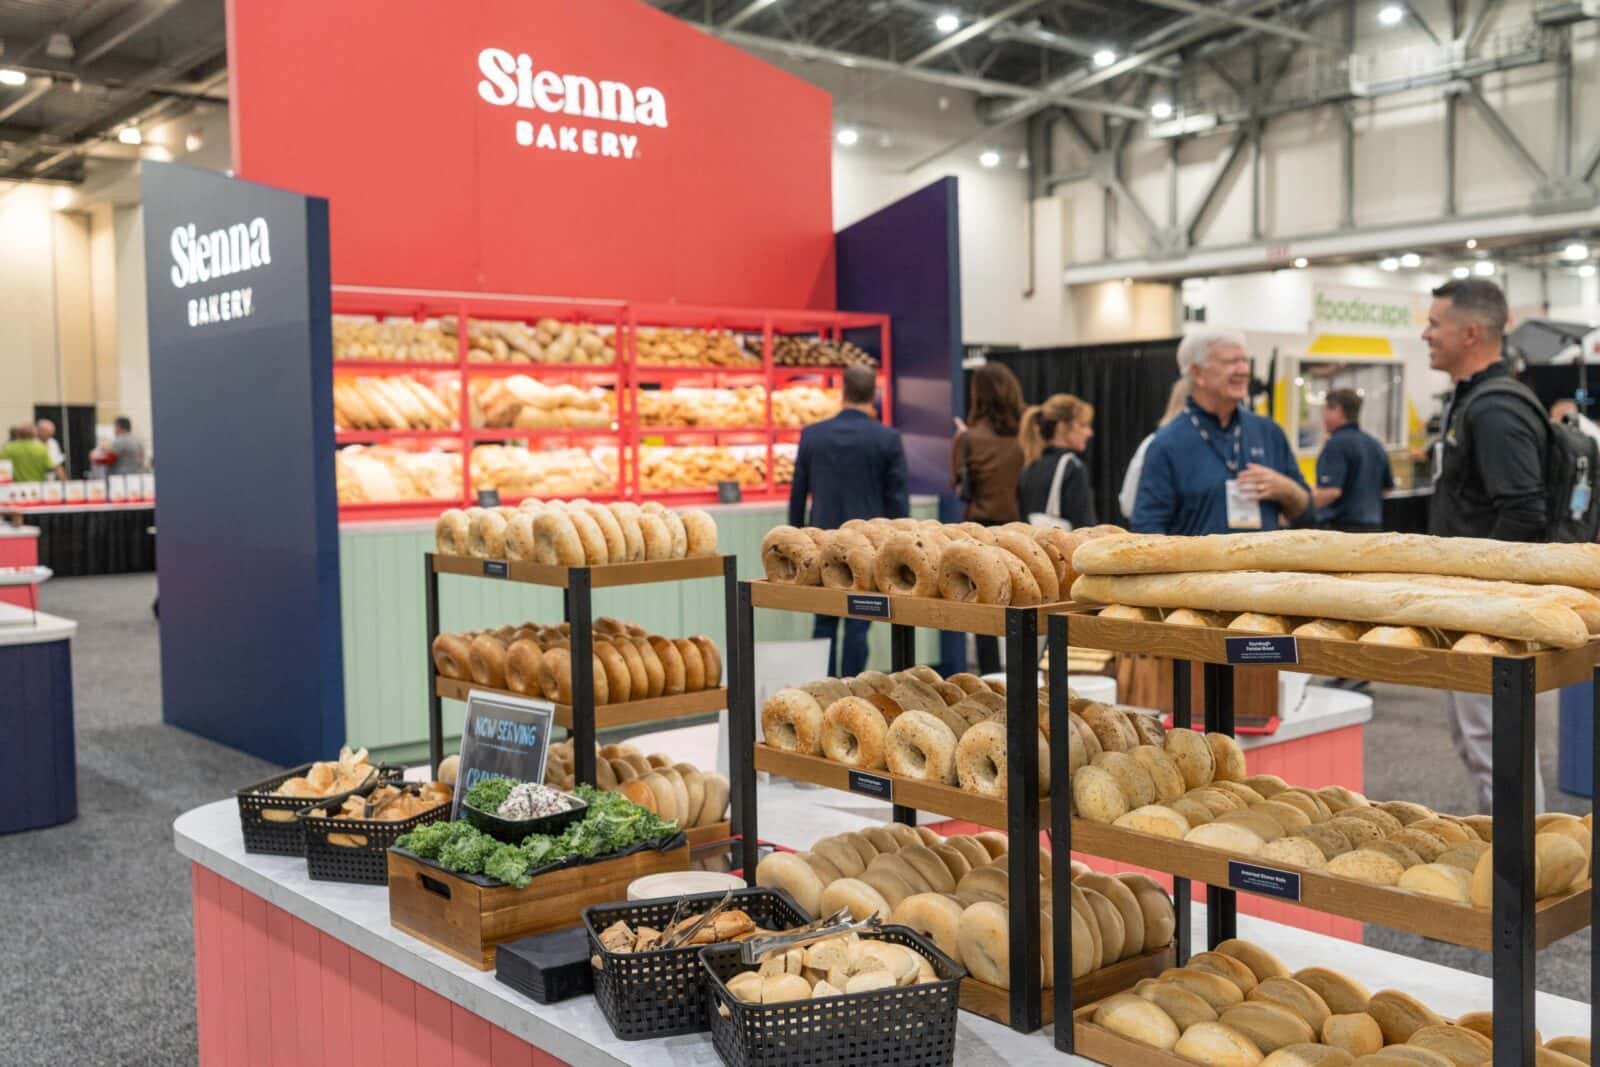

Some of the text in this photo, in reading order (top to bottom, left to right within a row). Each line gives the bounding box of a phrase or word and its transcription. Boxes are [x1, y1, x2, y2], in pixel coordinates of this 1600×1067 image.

[478, 48, 668, 128] Sienna
[515, 120, 638, 159] BAKERY
[170, 217, 271, 288] Sienna
[188, 287, 253, 327] BAKERY
[474, 715, 536, 746] NOW SERVING
